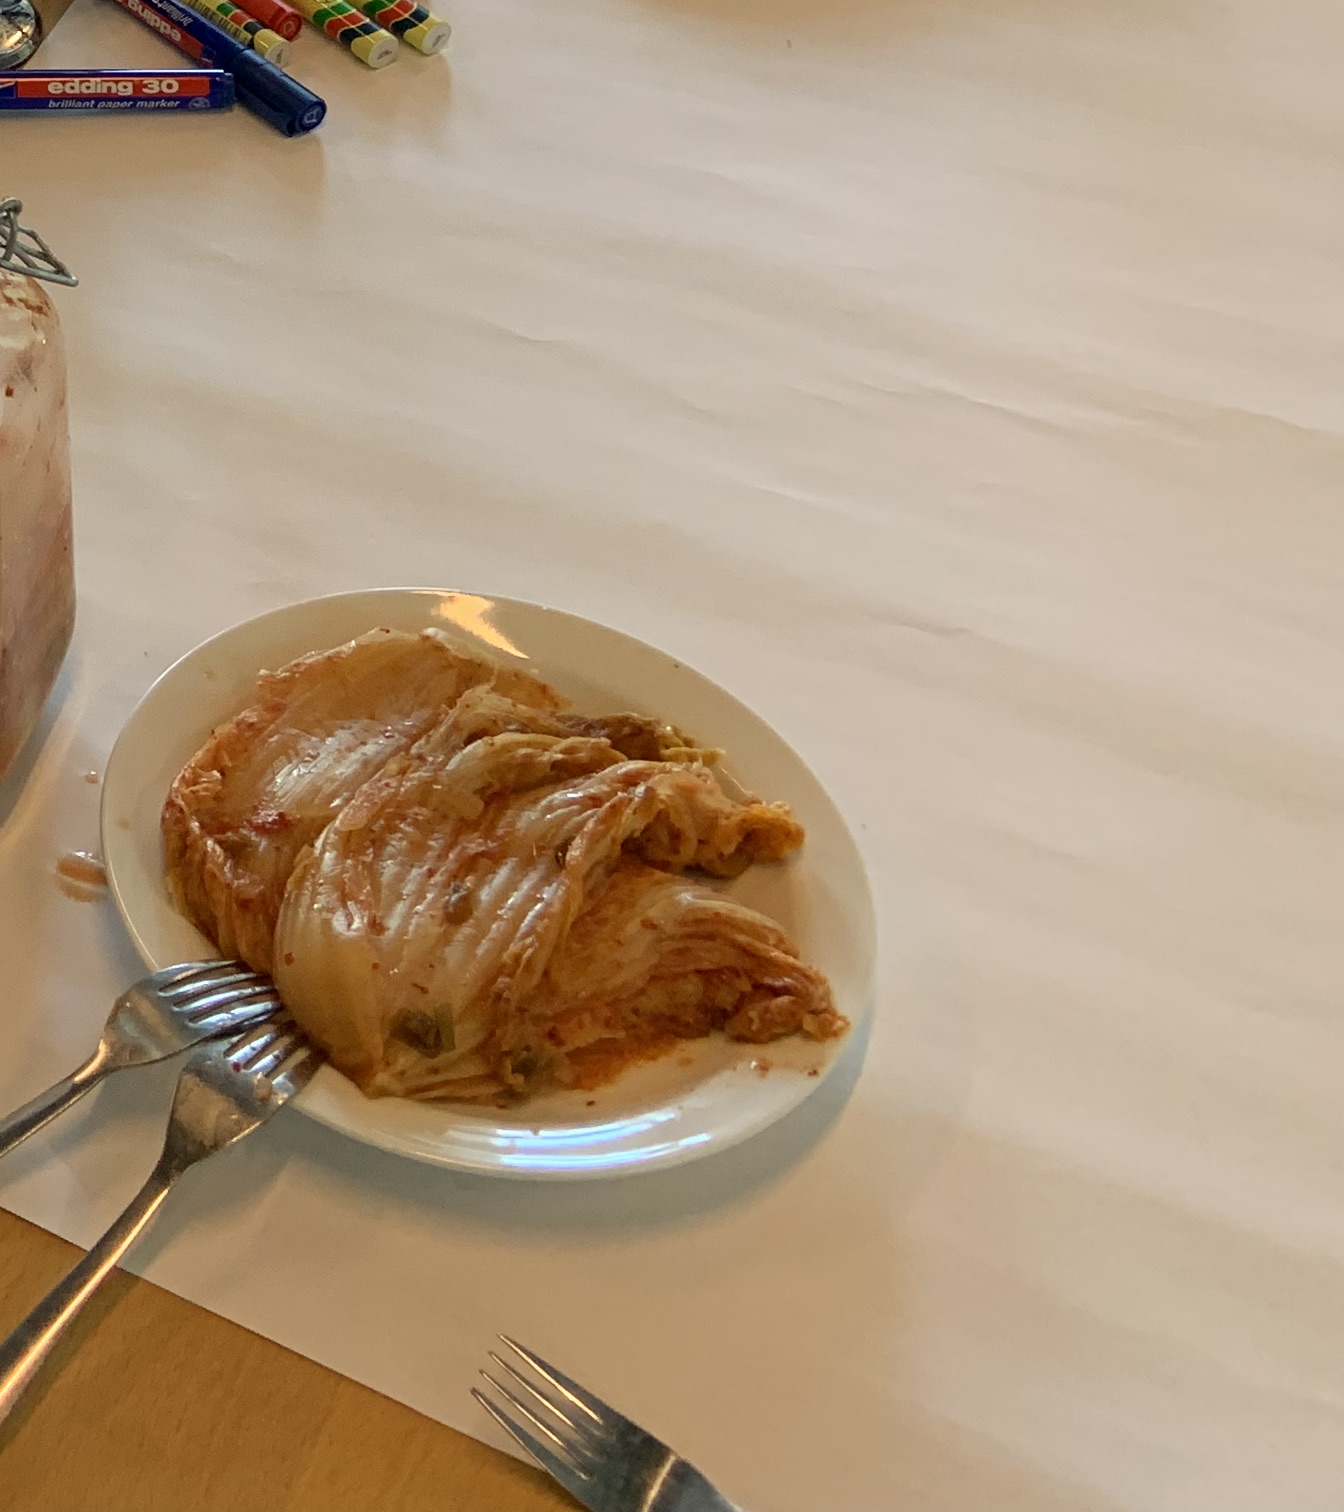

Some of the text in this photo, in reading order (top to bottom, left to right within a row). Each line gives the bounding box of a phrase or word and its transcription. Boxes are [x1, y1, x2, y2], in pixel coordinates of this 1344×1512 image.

[46, 78, 180, 96] edding 30
[47, 98, 181, 110] brilliant paper marker
